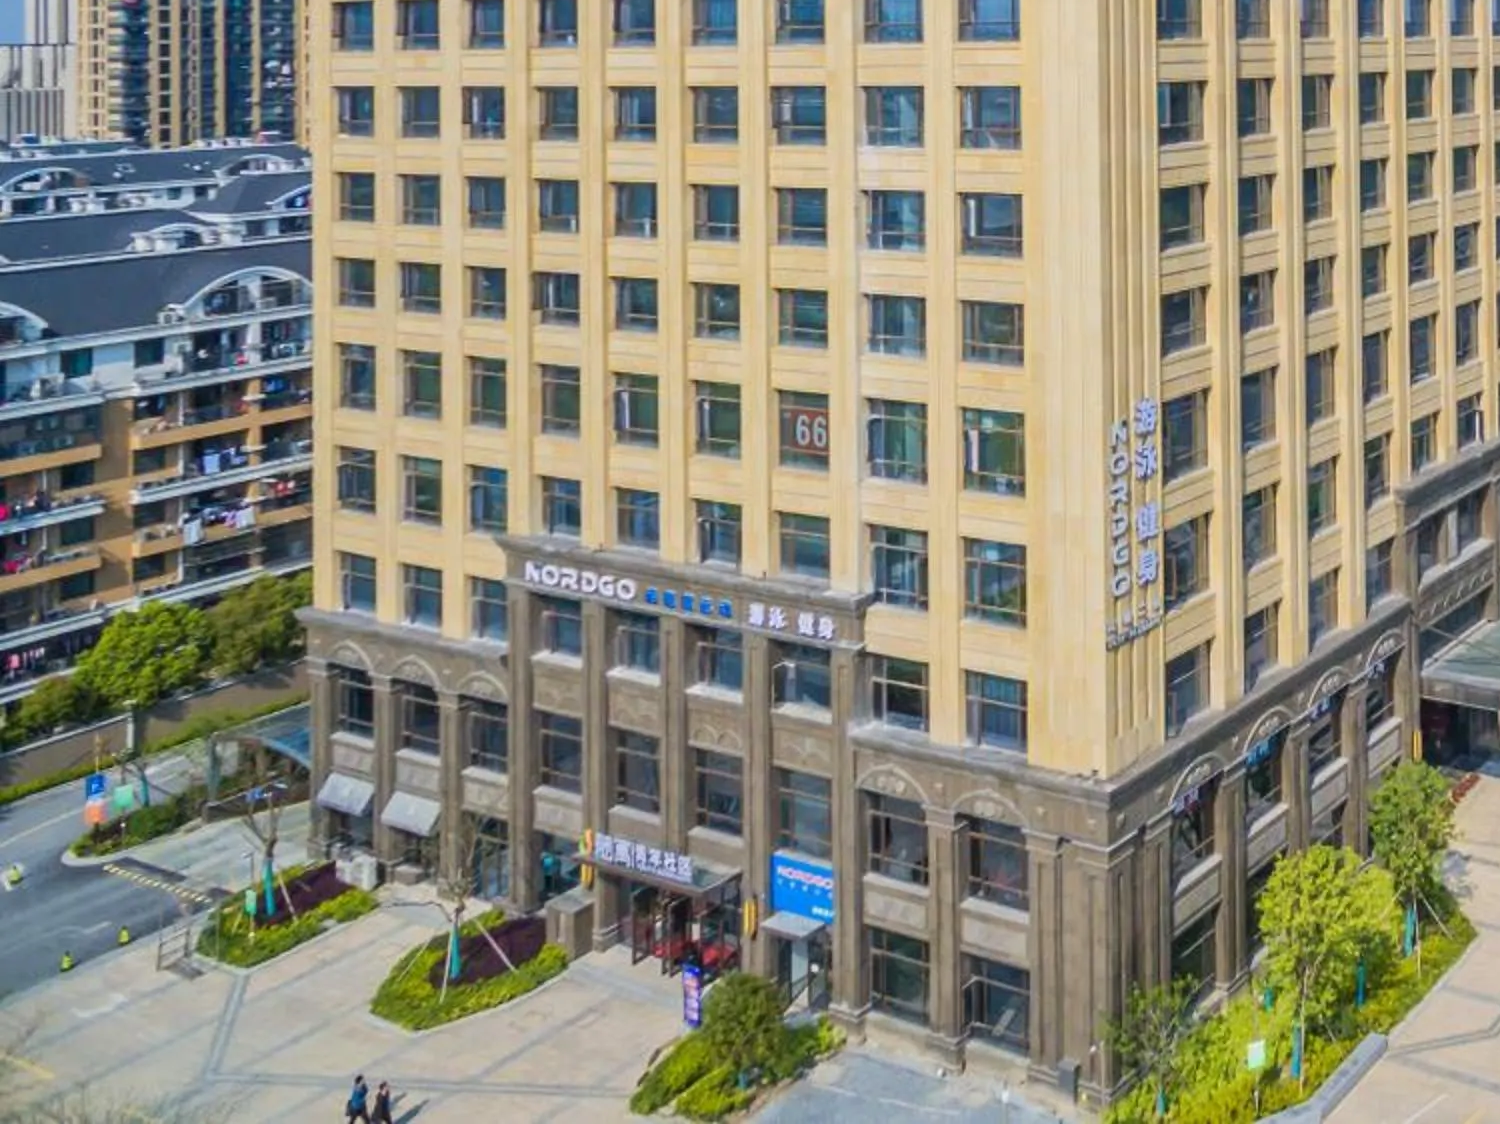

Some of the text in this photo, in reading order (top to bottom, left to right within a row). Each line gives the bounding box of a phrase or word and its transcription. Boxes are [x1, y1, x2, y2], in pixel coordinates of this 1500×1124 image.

[795, 414, 828, 448] 66
[1109, 419, 1132, 598] NORDGO
[524, 560, 637, 601] NORDGO
